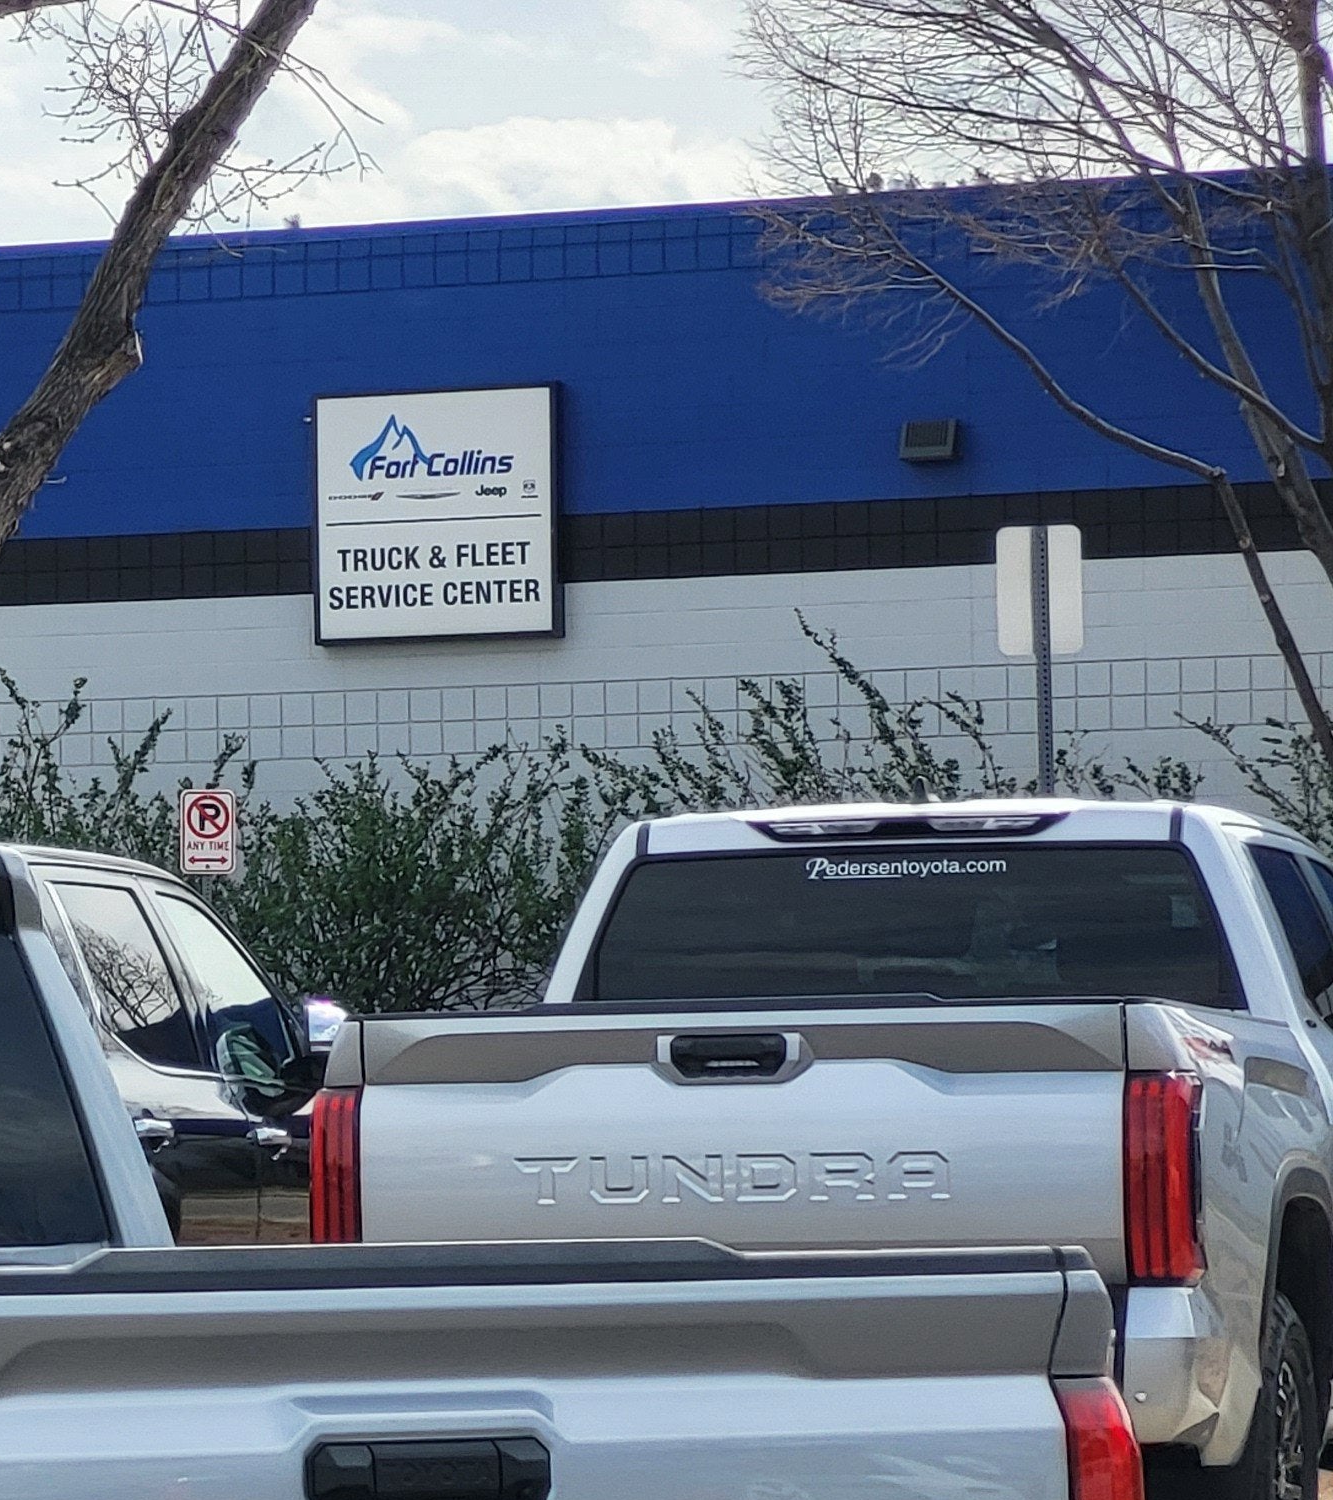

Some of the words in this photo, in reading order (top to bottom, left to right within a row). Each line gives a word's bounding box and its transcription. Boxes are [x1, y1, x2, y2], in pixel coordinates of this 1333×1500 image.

[367, 453, 419, 480] Fort
[426, 450, 514, 477] Collins
[475, 485, 507, 498] Jeep
[337, 546, 421, 572] TRUCK
[429, 545, 447, 568] &
[456, 541, 530, 567] FLEET
[329, 583, 433, 610] SERVICE
[442, 579, 540, 606] CENTER
[187, 841, 205, 851] ANY
[209, 840, 229, 851] TIME
[806, 858, 1006, 880] Pedersentoyota.com
[513, 1150, 950, 1204] TUNDRA
